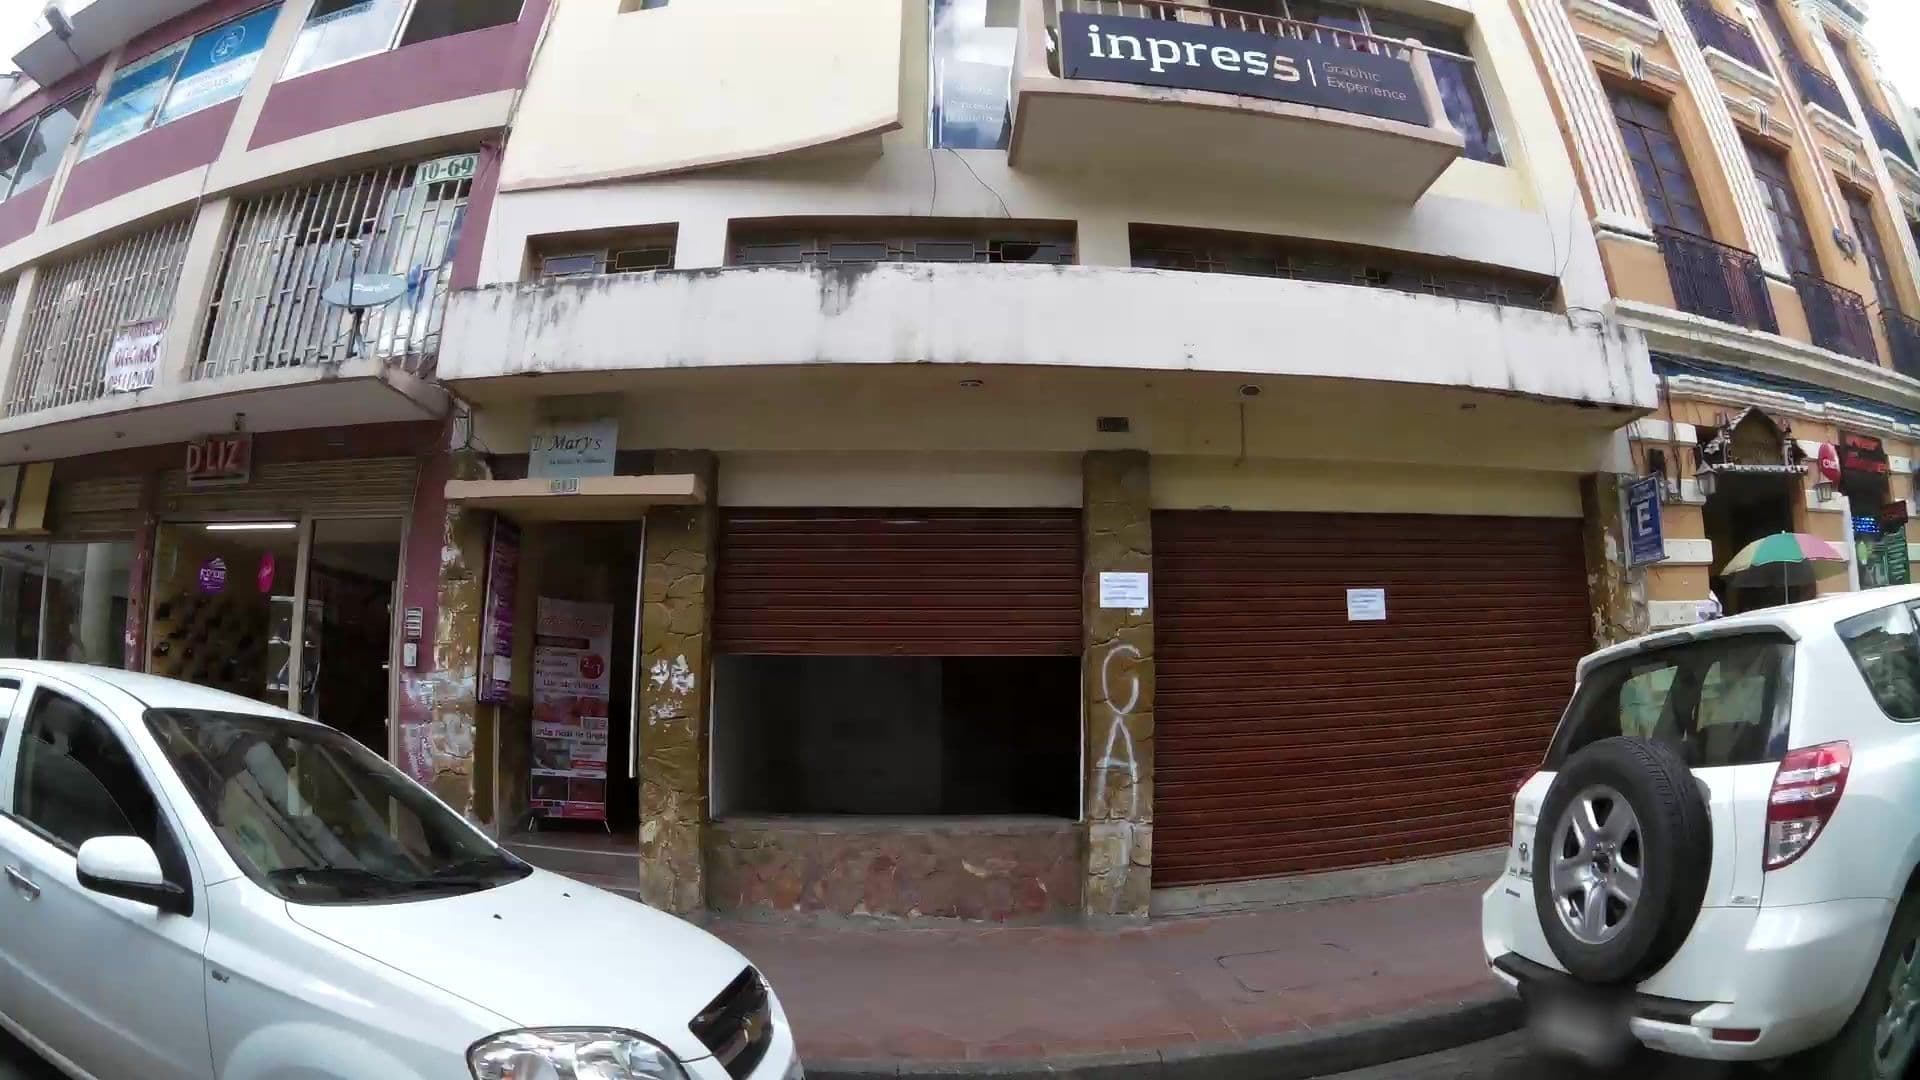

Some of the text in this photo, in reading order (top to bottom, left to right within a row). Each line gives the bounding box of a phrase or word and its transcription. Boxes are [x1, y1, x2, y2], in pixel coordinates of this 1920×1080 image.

[1088, 24, 1300, 83] inpress
[1322, 61, 1381, 83] Graphic
[1327, 77, 1408, 101] Experience
[421, 156, 475, 181] 10-69
